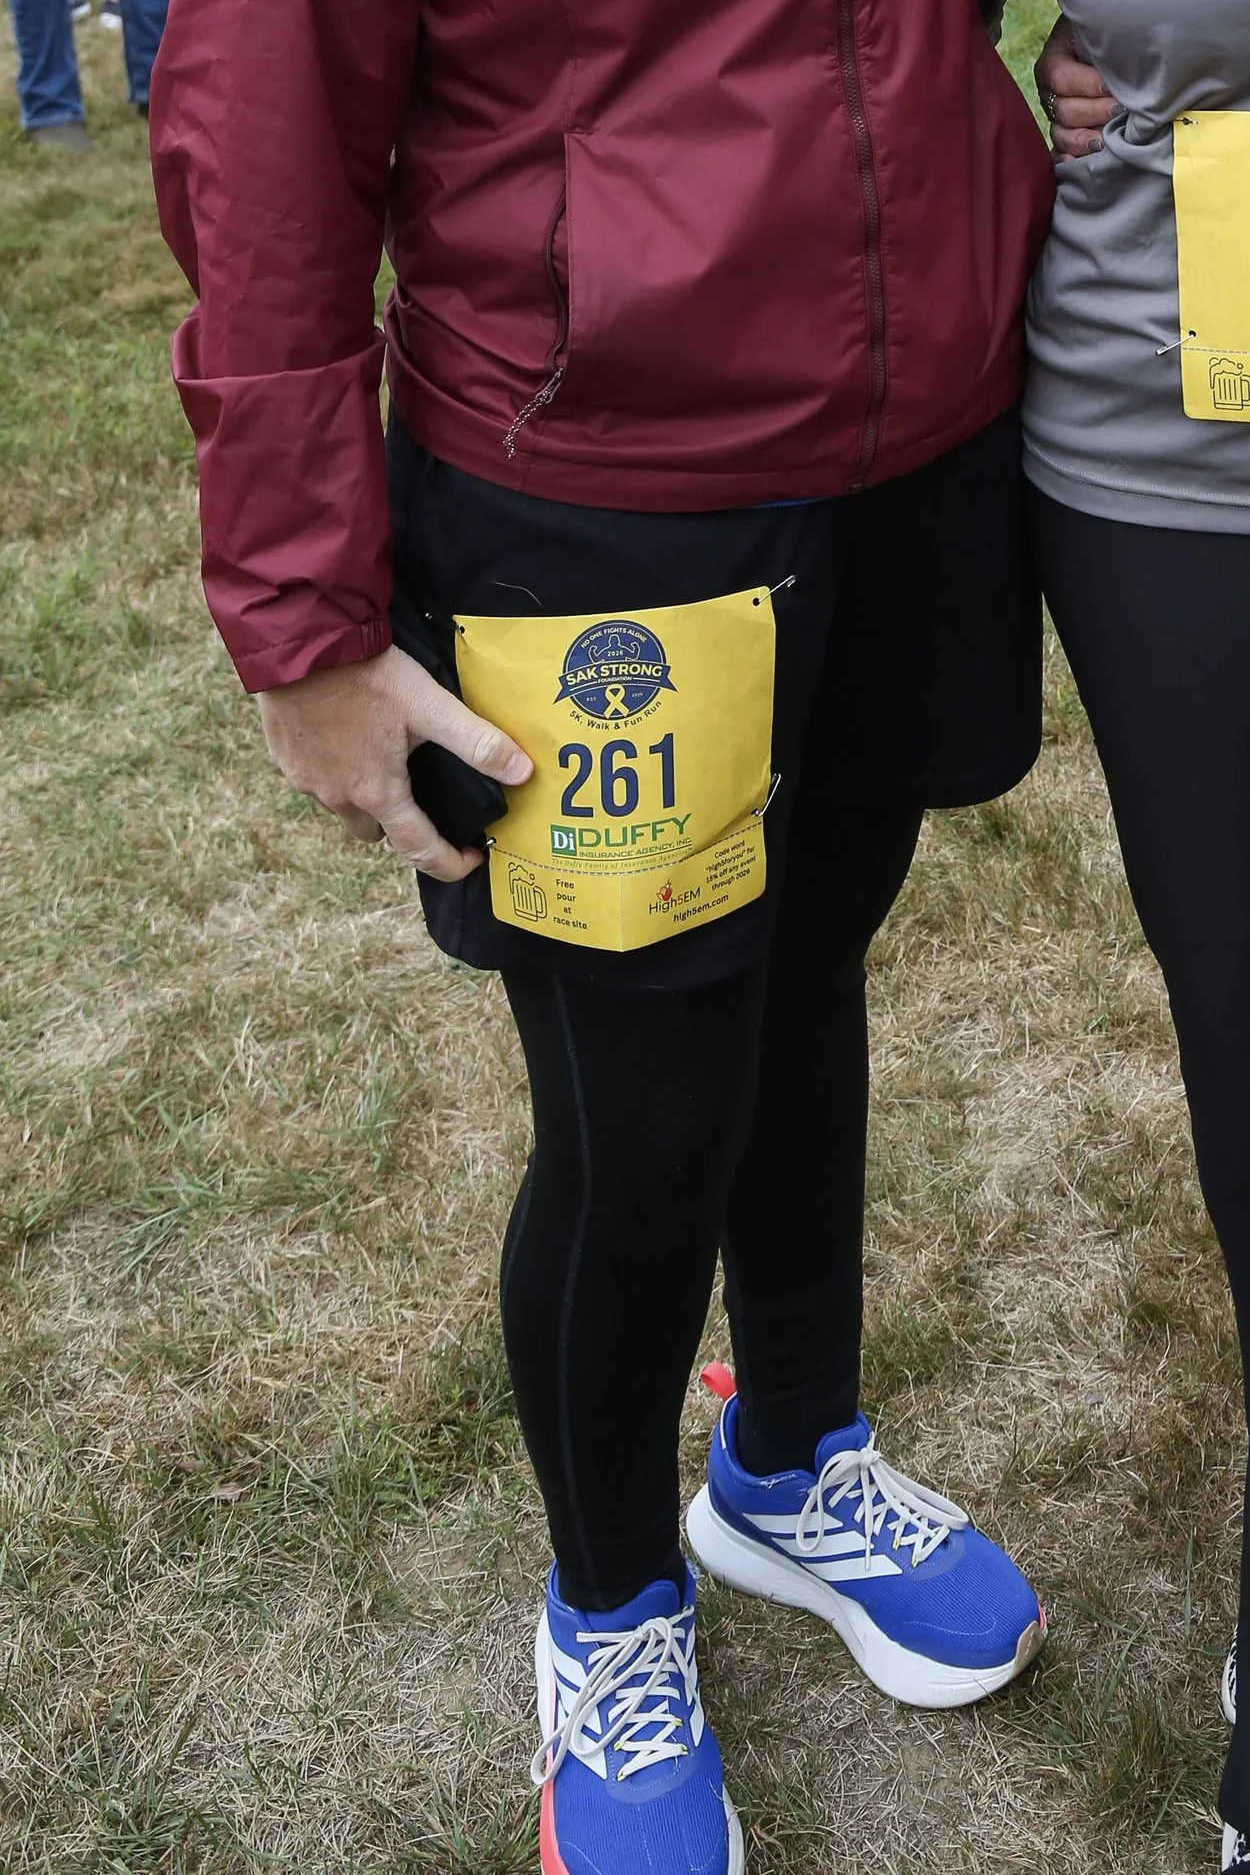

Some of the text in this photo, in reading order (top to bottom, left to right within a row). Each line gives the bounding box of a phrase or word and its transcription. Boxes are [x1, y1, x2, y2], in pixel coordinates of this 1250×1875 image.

[581, 627, 647, 649] NO ONE FIGHTS ALONE
[566, 664, 663, 685] SAK STRONG
[569, 710, 583, 724] 5K,
[587, 719, 610, 730] Walk
[624, 717, 643, 728] Fun
[643, 701, 662, 717] Run
[558, 733, 676, 818] 261
[578, 813, 692, 847] DUFFY
[635, 842, 675, 855] AGENCY,
[714, 840, 745, 859] Code word
[746, 846, 755, 854] for
[565, 860, 582, 868] Duffy
[621, 858, 656, 868] Insurance
[706, 856, 756, 884] 15% off any event
[556, 879, 574, 889] Free
[711, 868, 751, 891] through 2026
[557, 893, 576, 901] pour
[649, 886, 700, 915] High5EM
[673, 894, 729, 922] high5em.com
[554, 917, 587, 929] race site
